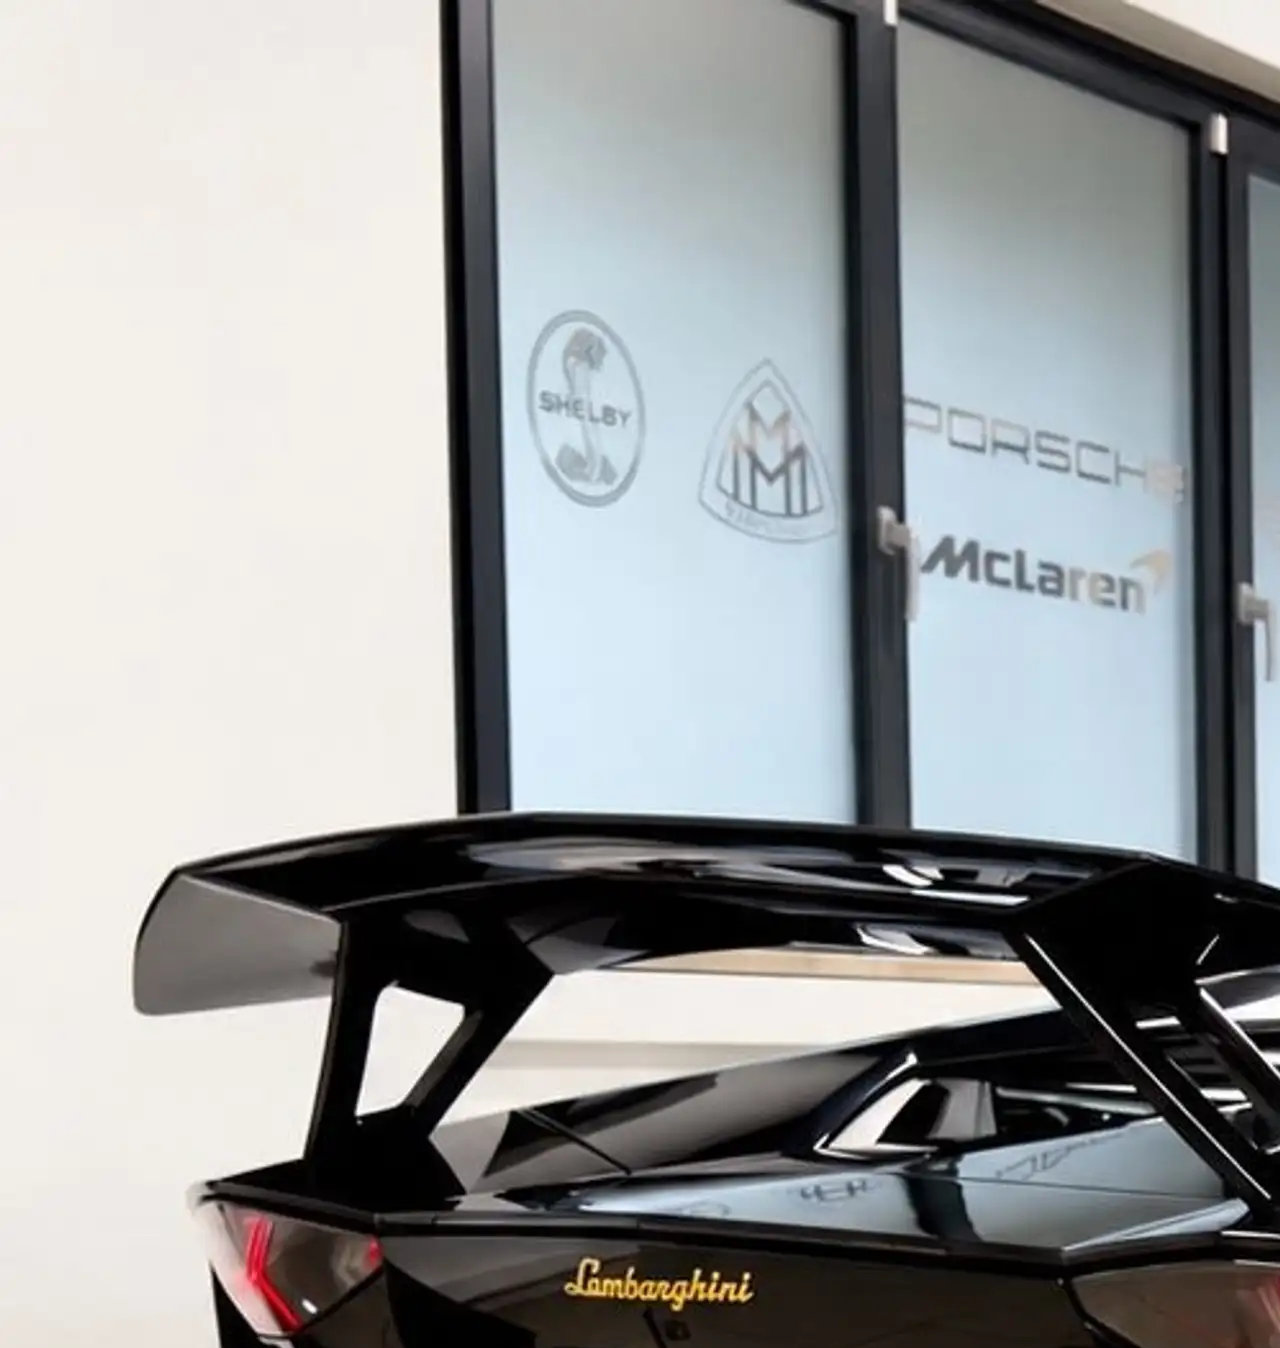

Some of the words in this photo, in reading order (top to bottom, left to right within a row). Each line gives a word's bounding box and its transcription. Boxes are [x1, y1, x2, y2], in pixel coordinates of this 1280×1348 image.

[538, 390, 633, 428] SHELBY
[920, 535, 1147, 616] McLaren
[564, 1256, 754, 1312] Lamborghini
